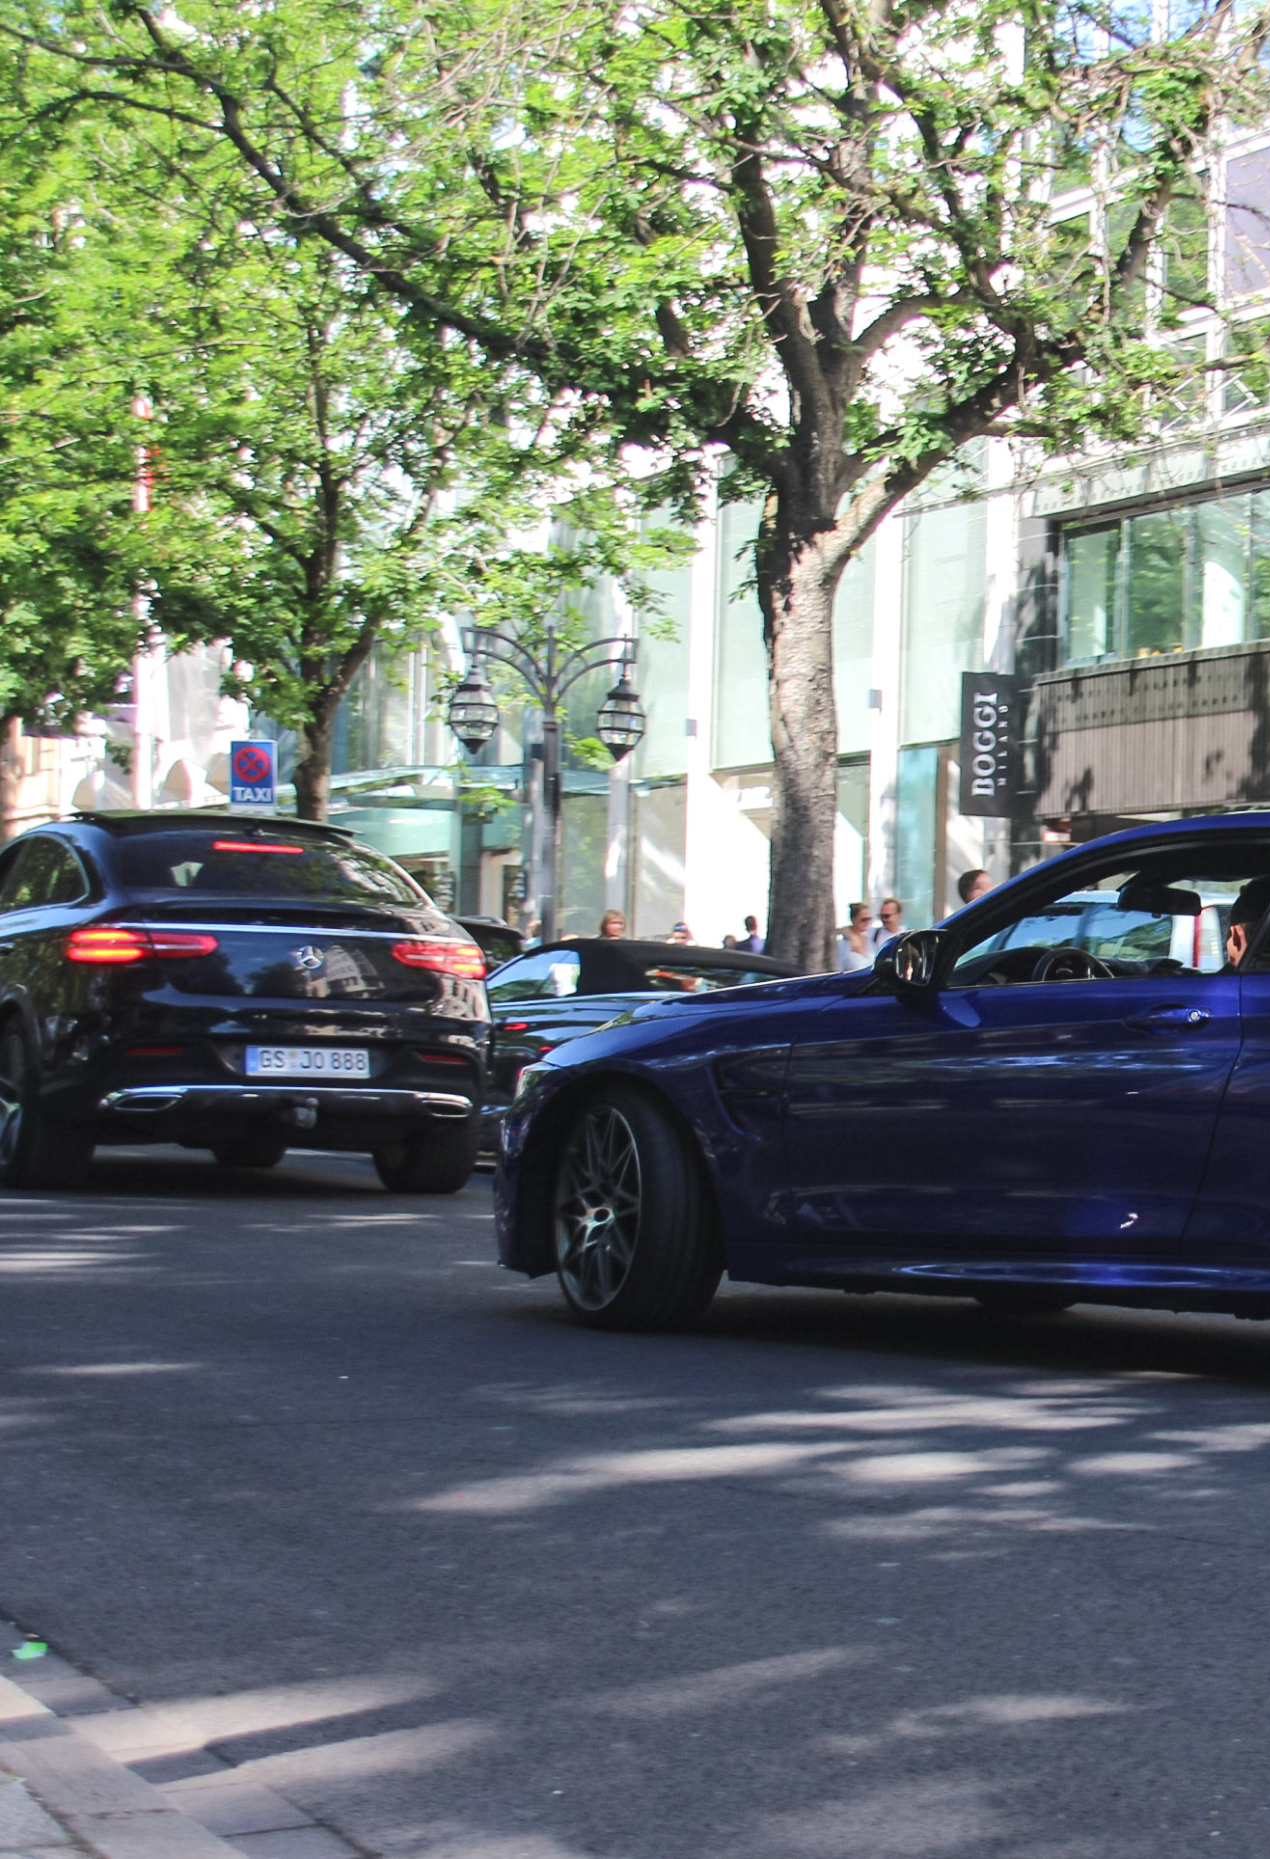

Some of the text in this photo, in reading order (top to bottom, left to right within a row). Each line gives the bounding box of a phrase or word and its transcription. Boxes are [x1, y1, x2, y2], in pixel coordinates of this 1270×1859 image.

[971, 692, 998, 797] BOGGI
[997, 705, 1009, 787] MILANO
[233, 786, 272, 802] TAXI
[260, 1050, 285, 1068] GS
[331, 1052, 366, 1071] 888
